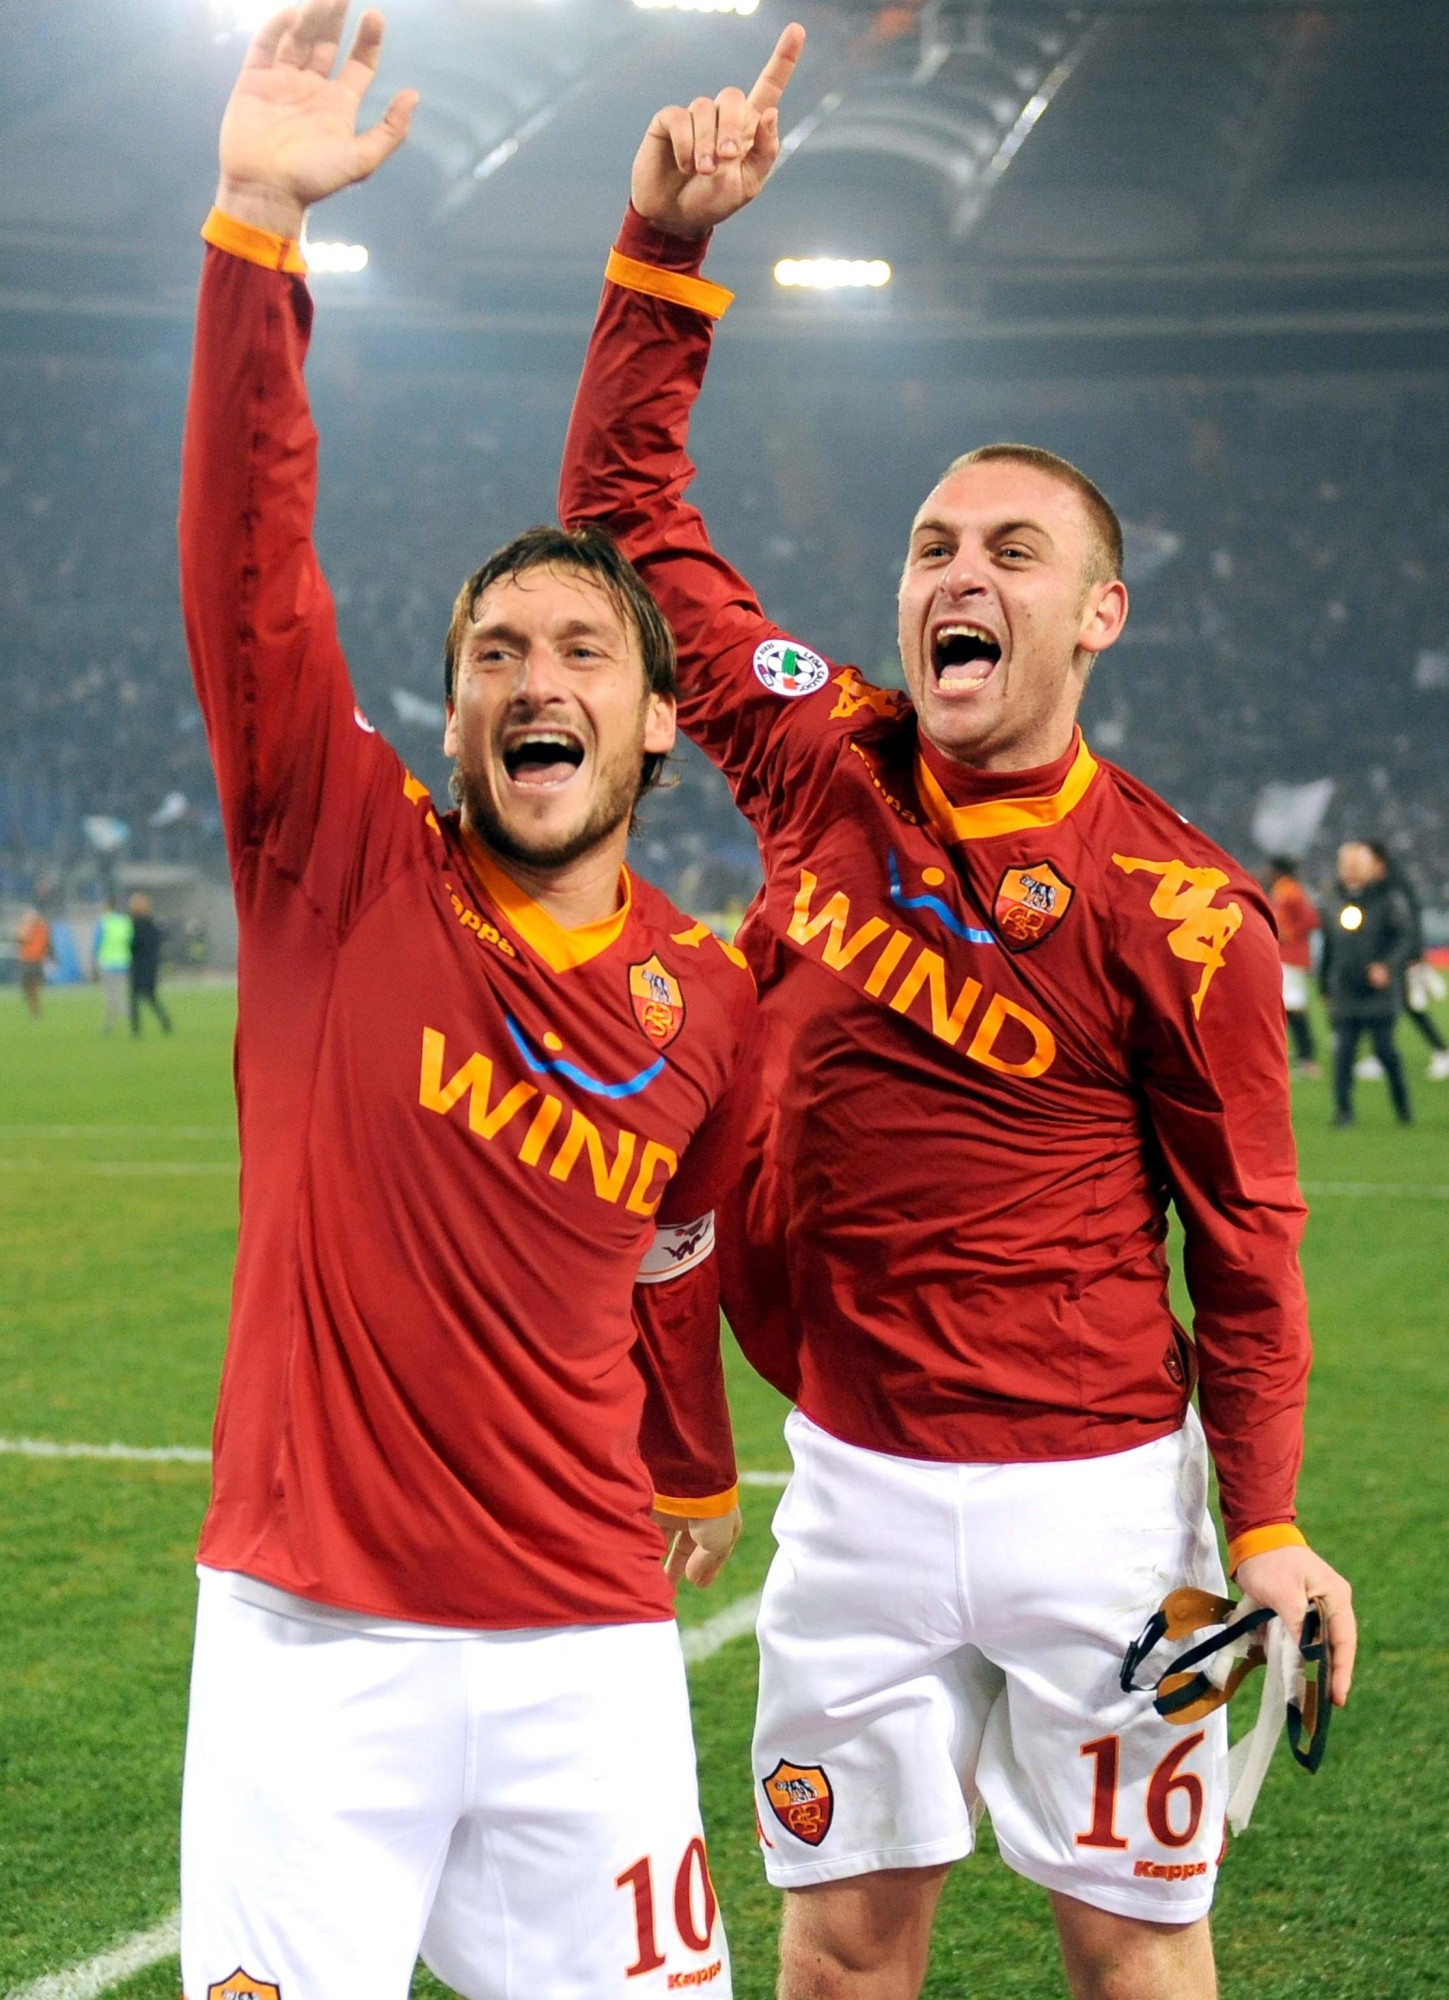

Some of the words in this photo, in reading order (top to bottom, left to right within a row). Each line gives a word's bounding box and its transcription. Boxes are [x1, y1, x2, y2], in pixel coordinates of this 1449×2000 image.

[800, 670, 826, 691] CALCIO
[803, 652, 823, 669] LEGA
[444, 882, 516, 958] appa
[786, 868, 1056, 1078] WIND
[419, 1026, 678, 1216] WIND
[1074, 1730, 1206, 1850] 16
[614, 1834, 718, 1979] 10
[1133, 1859, 1208, 1882] Kappa
